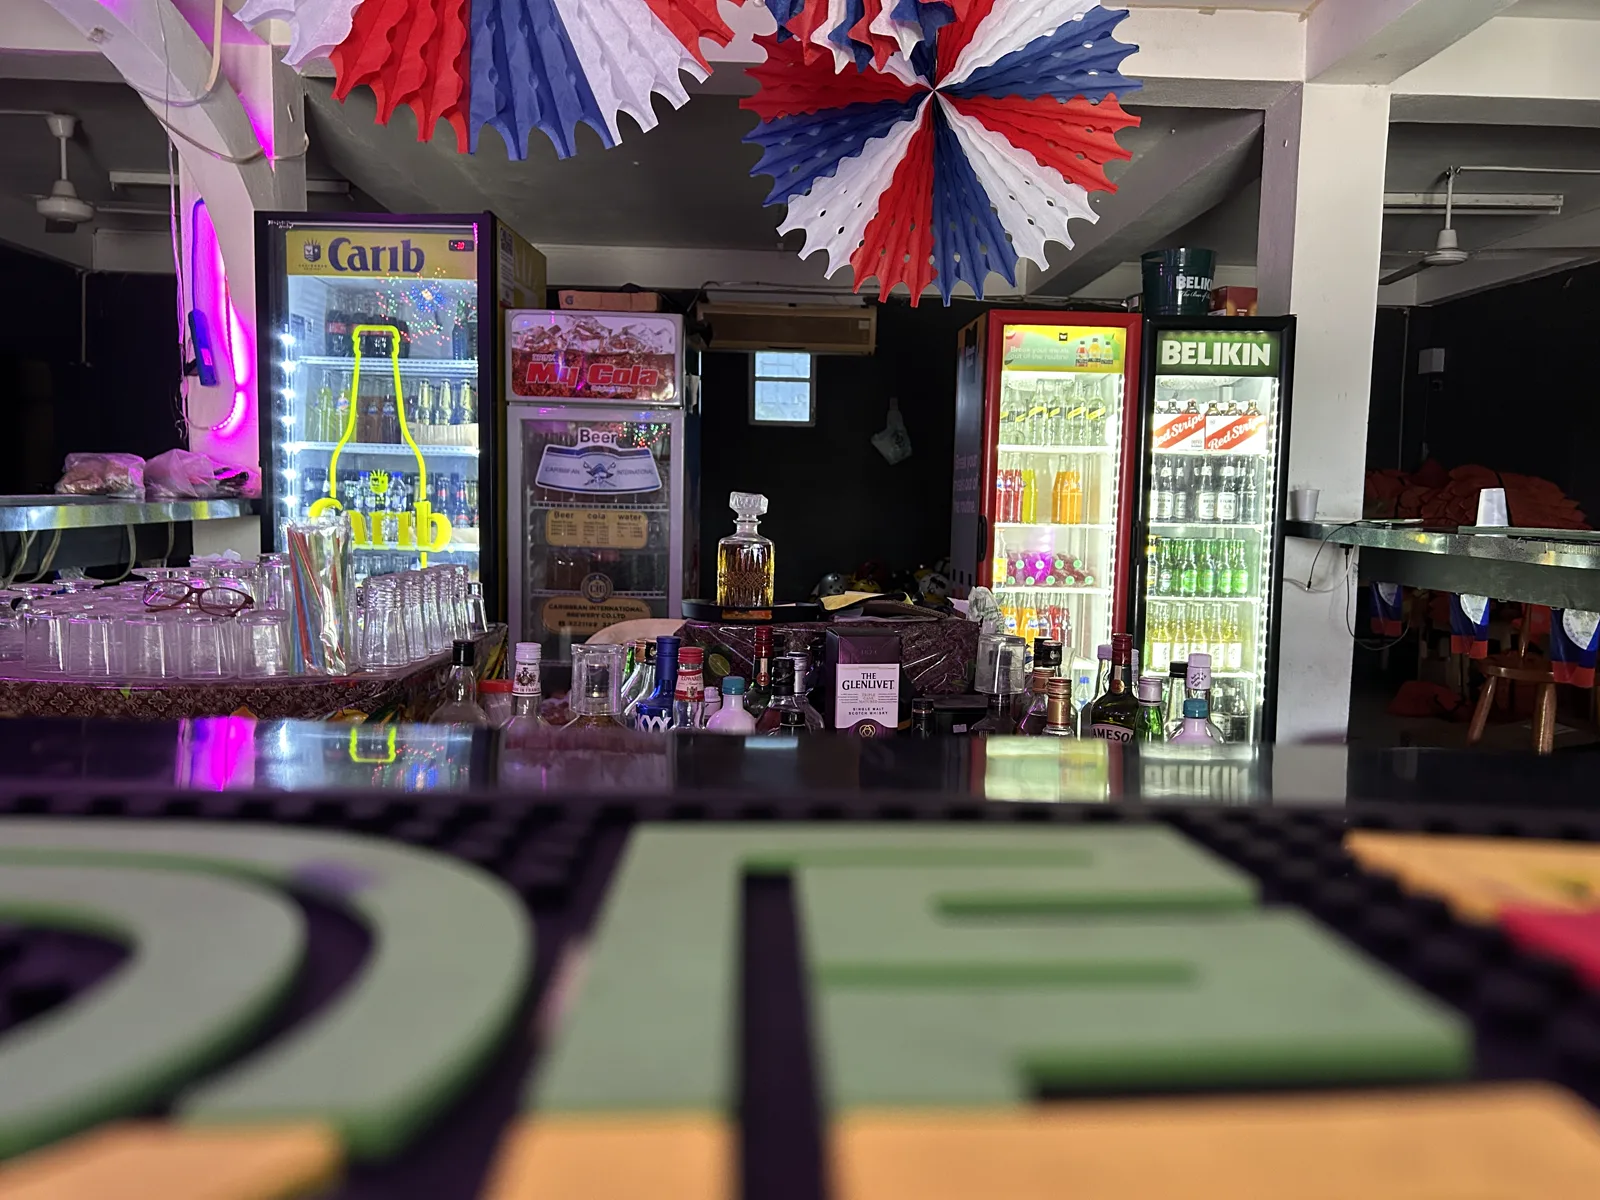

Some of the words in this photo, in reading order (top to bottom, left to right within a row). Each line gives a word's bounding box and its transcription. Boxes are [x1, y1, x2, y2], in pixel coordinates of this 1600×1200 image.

[327, 237, 425, 273] Carib
[1161, 340, 1271, 367] BELIKIN
[526, 362, 580, 387] My
[587, 363, 659, 387] Cola
[580, 429, 617, 443] Beer
[1207, 434, 1232, 450] Red
[587, 511, 606, 520] cola
[618, 512, 642, 521] water
[589, 604, 644, 613] INTERNATIONAL
[861, 672, 877, 680] THE
[842, 679, 895, 690] GLENLIVET
[634, 713, 672, 734] KYY
[1091, 728, 1133, 744] AMESO
